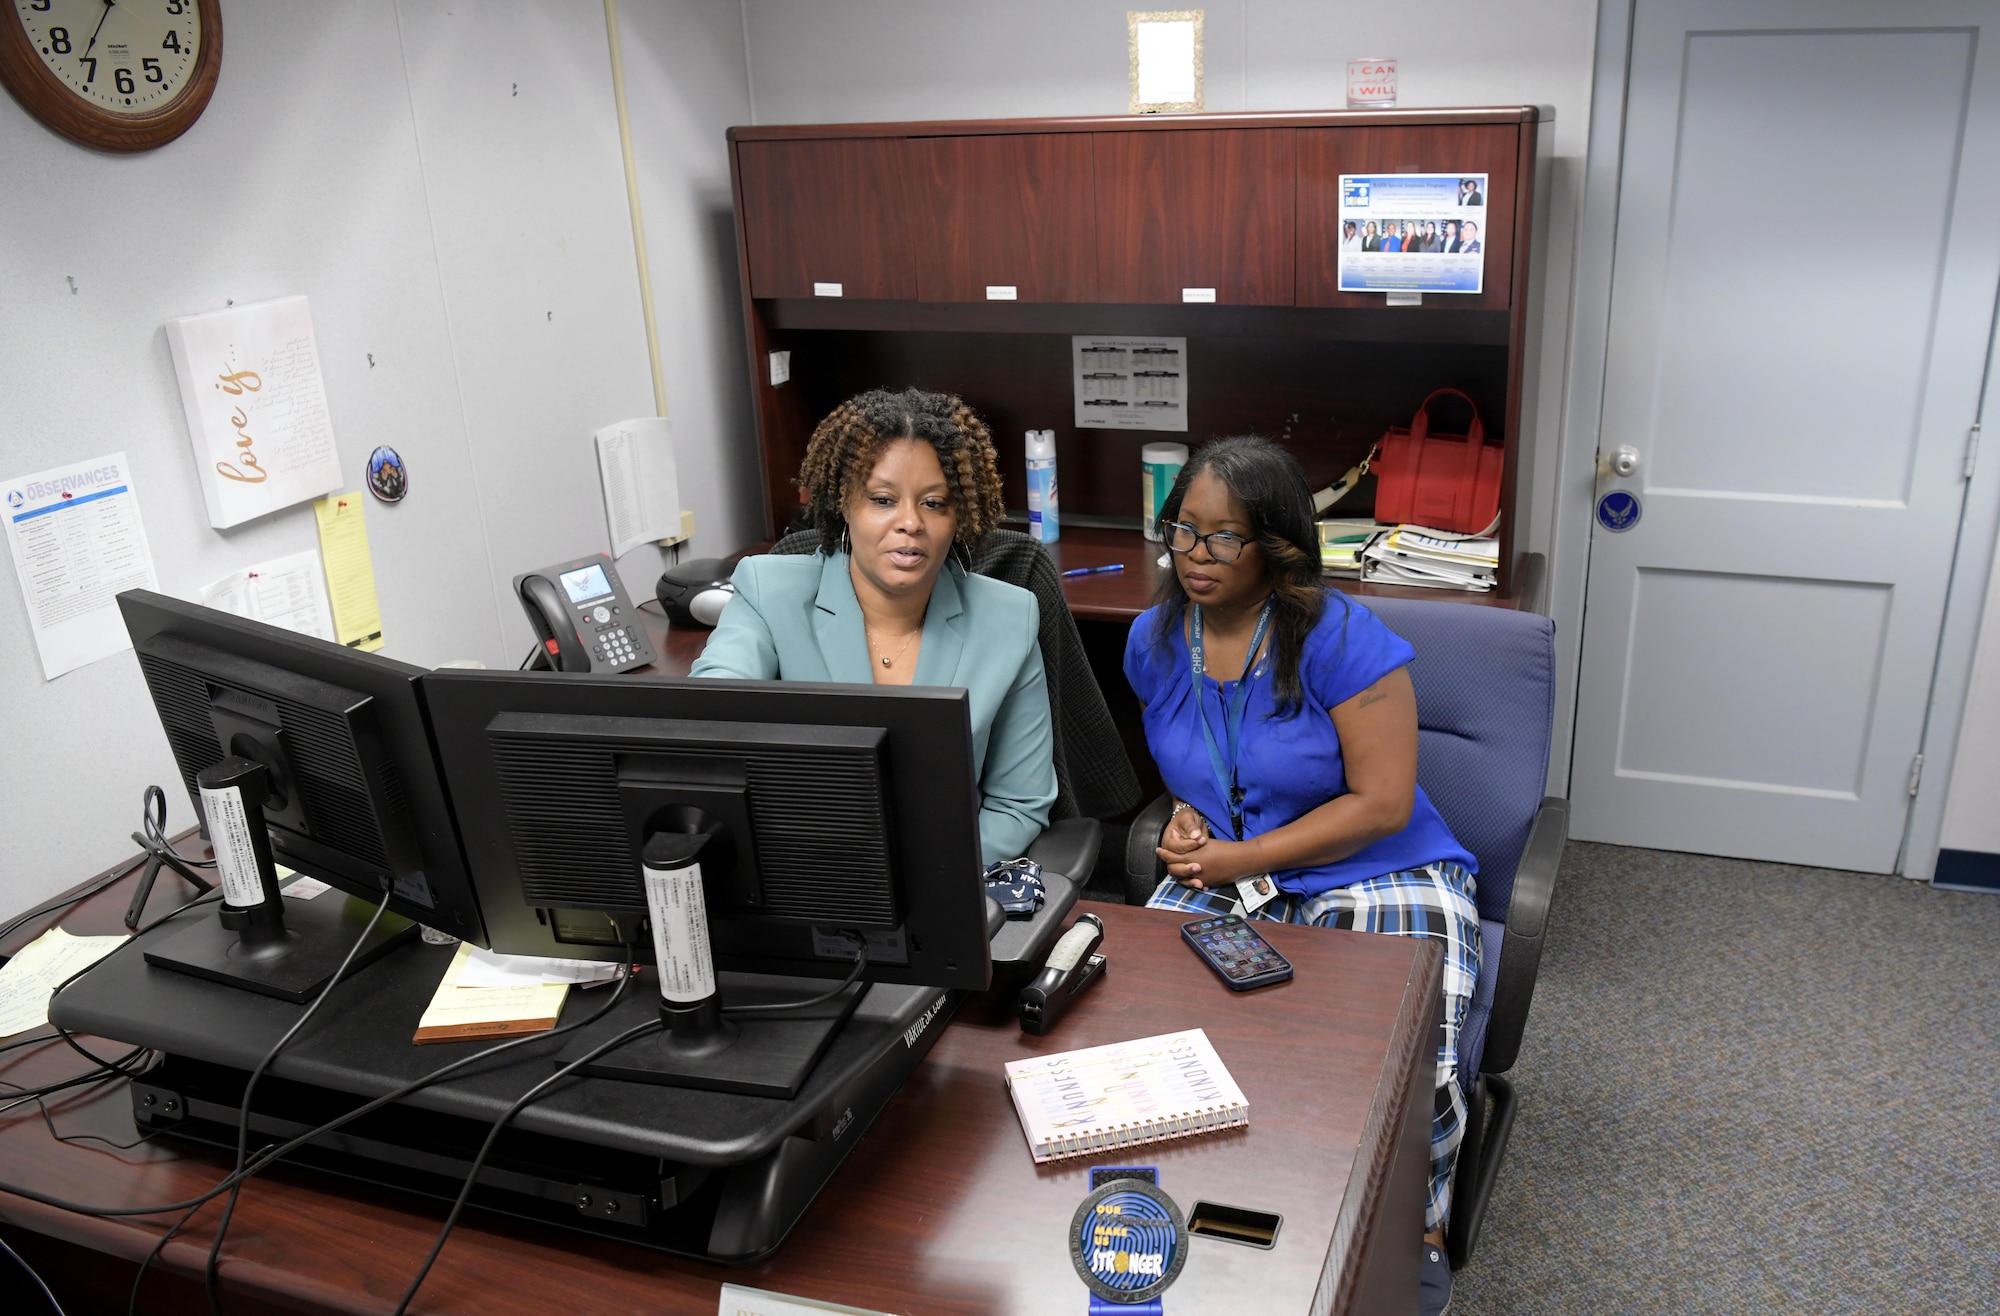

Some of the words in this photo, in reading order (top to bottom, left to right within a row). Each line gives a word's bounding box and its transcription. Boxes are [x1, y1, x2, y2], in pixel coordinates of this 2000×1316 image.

[49, 27, 72, 54] 8
[162, 30, 181, 54] 4
[79, 57, 97, 83] 7
[114, 68, 136, 95] 6
[142, 57, 163, 83] 5
[1361, 66, 1395, 75] CAN
[1359, 86, 1396, 95] WILL
[215, 405, 267, 483] love
[26, 465, 120, 501] OBSERVANCES
[1192, 646, 1202, 674] CHPS
[903, 994, 947, 1049] VARIDESK.com
[1095, 1204, 1122, 1216] OUR
[1093, 1225, 1128, 1237] MAKE
[1093, 1235, 1110, 1246] US
[1091, 1248, 1163, 1277] STRONGER
